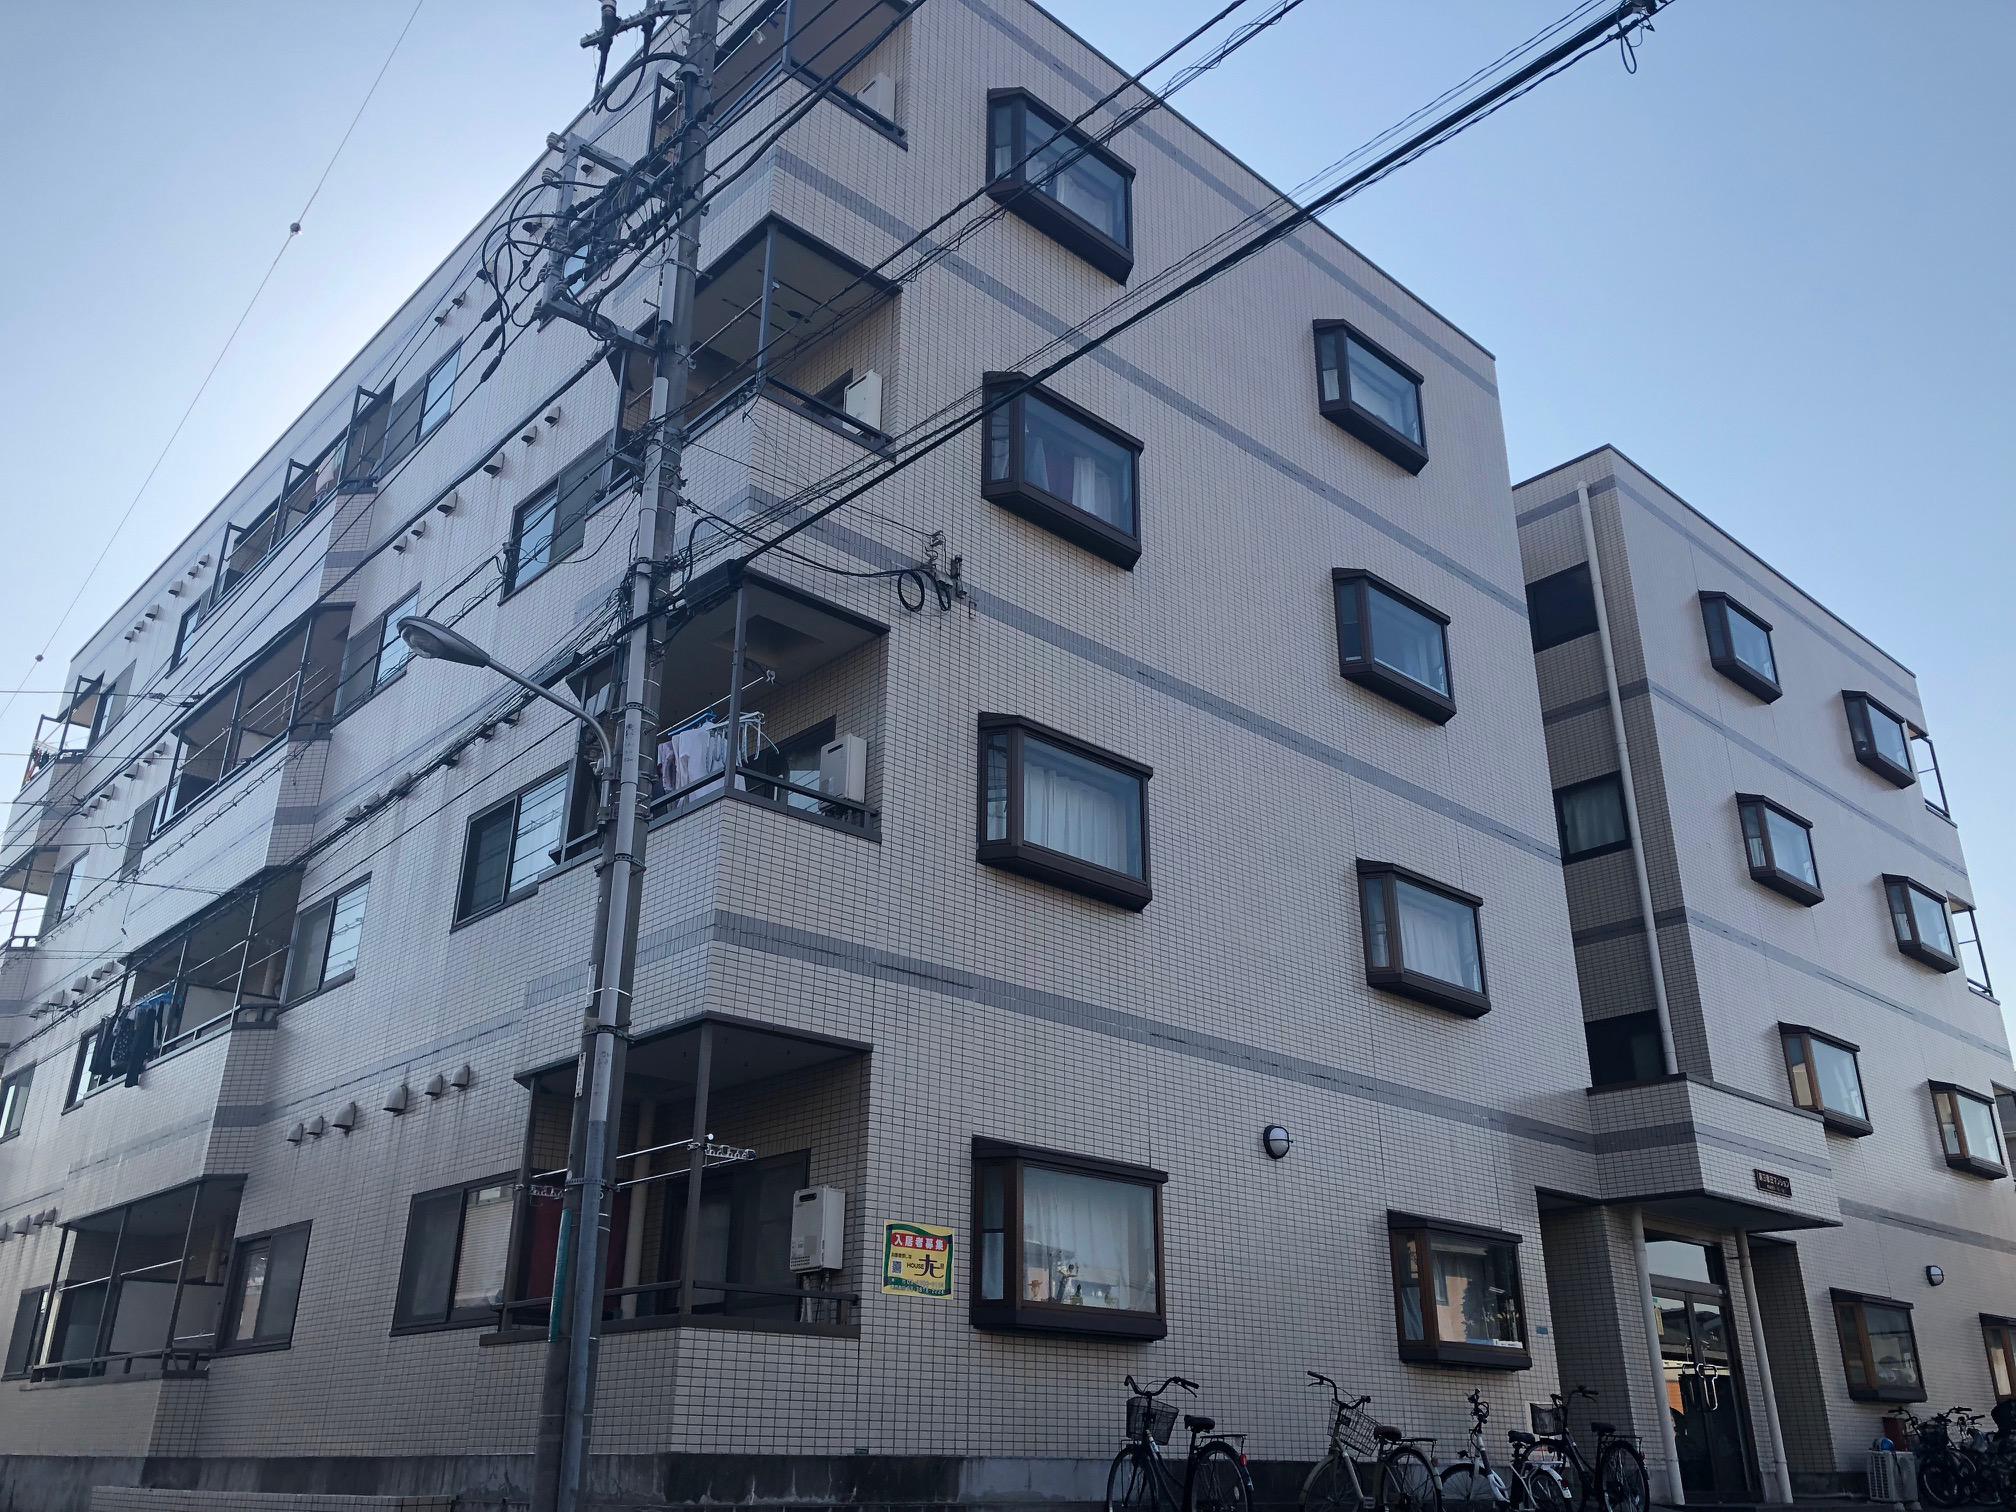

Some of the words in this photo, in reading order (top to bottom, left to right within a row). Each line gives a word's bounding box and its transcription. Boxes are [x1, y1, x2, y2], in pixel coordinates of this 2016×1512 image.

[894, 1234, 944, 1250] 入居者募集
